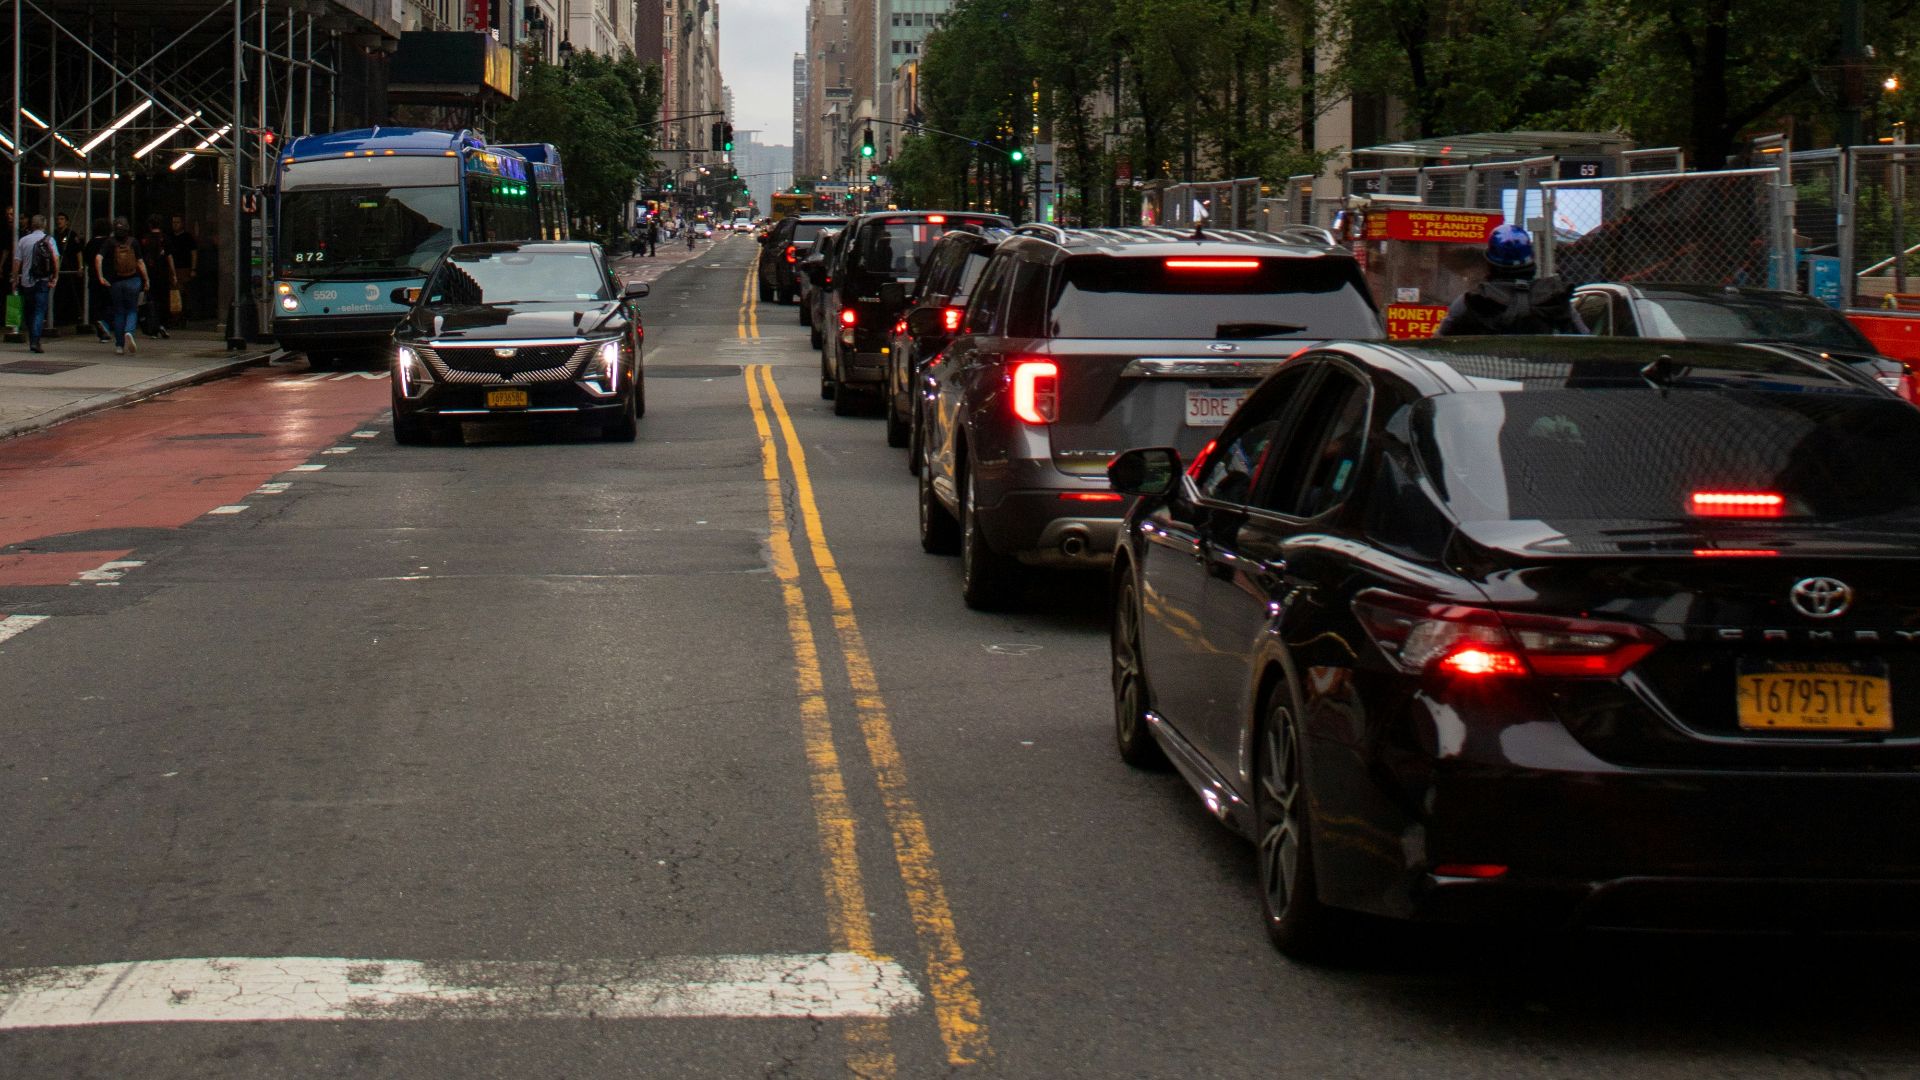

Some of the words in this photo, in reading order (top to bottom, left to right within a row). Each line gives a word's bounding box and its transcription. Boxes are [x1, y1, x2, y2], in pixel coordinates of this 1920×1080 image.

[1408, 212, 1442, 221] HONEY
[1443, 214, 1488, 223] ROASTED
[1426, 222, 1485, 231] PEANUTS
[1426, 230, 1485, 239] ALMONDS
[295, 252, 325, 262] 872
[313, 290, 337, 300] 5520
[1388, 308, 1433, 321] HONEY
[1751, 678, 1877, 714] T679517C
